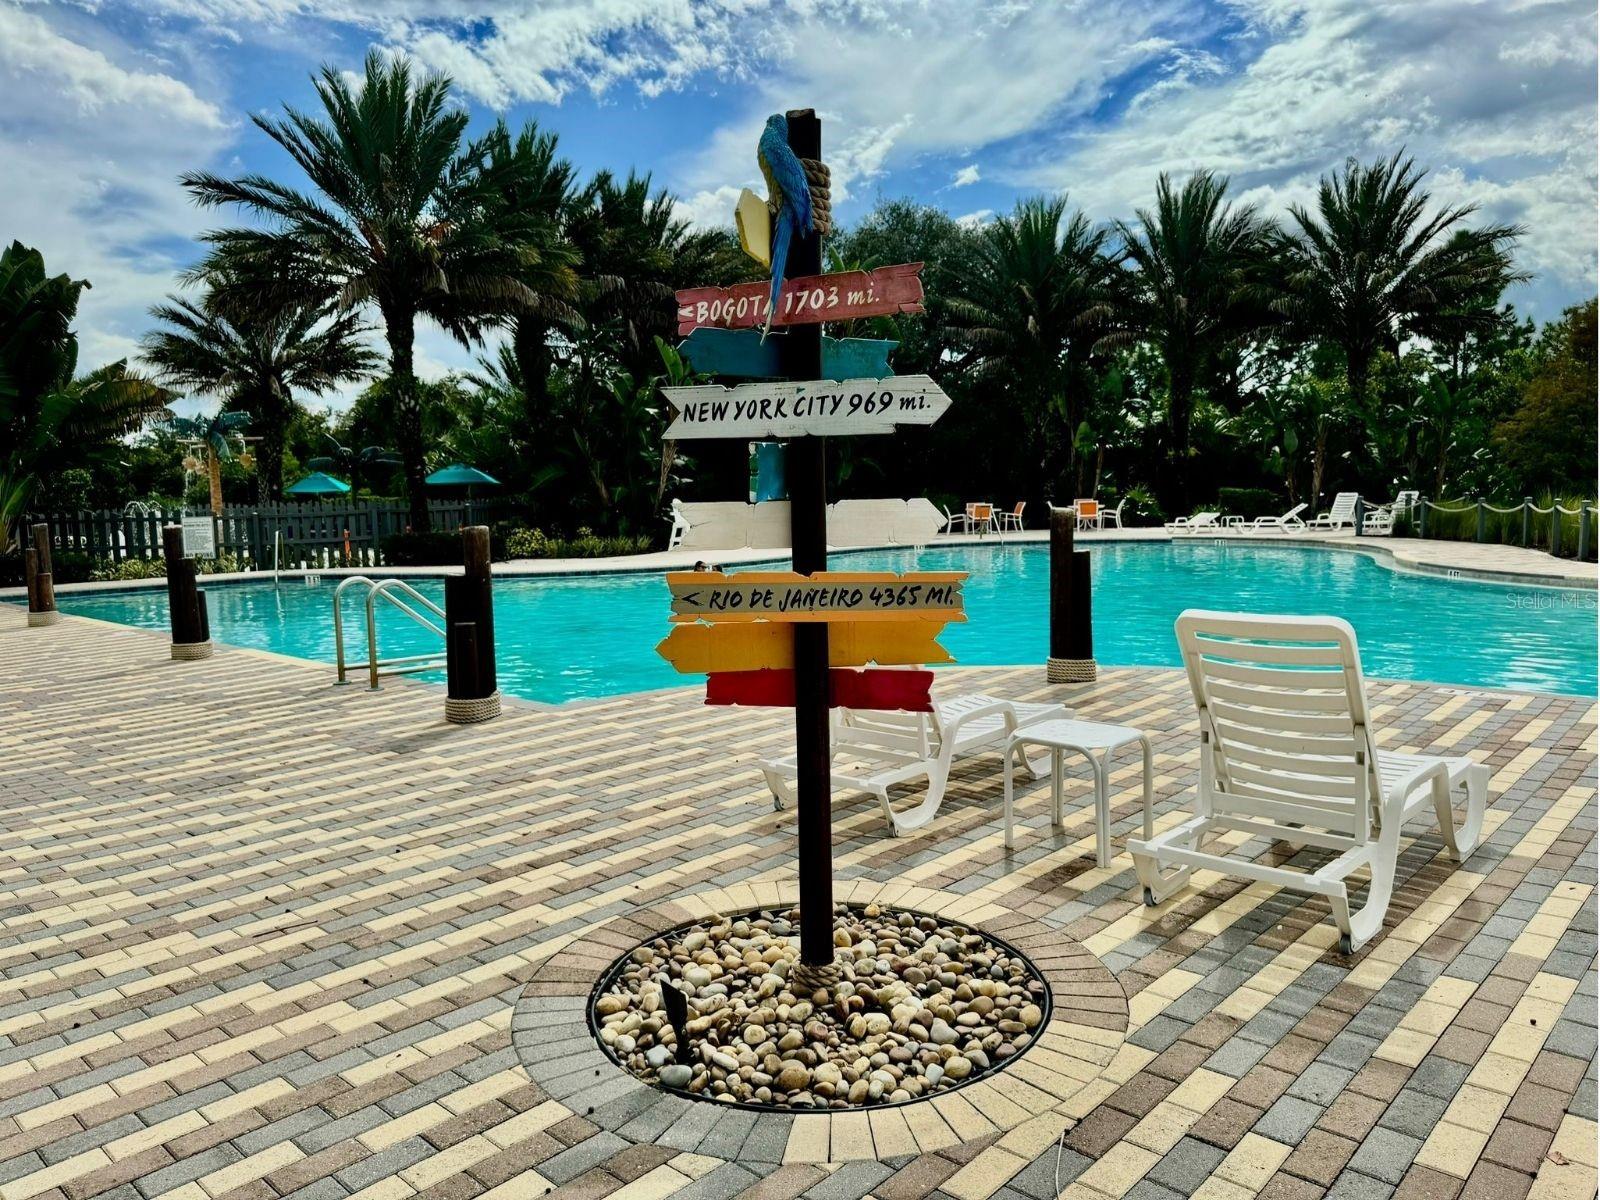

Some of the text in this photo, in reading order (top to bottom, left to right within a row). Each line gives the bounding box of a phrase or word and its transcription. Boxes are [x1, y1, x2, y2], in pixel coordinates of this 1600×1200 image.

[785, 287, 839, 315] 1703
[847, 281, 880, 305] mi.
[683, 391, 931, 423] NEW YORK CITY 969 mi.
[709, 585, 954, 612] RIO DE JANEIRO 4365 MI.
